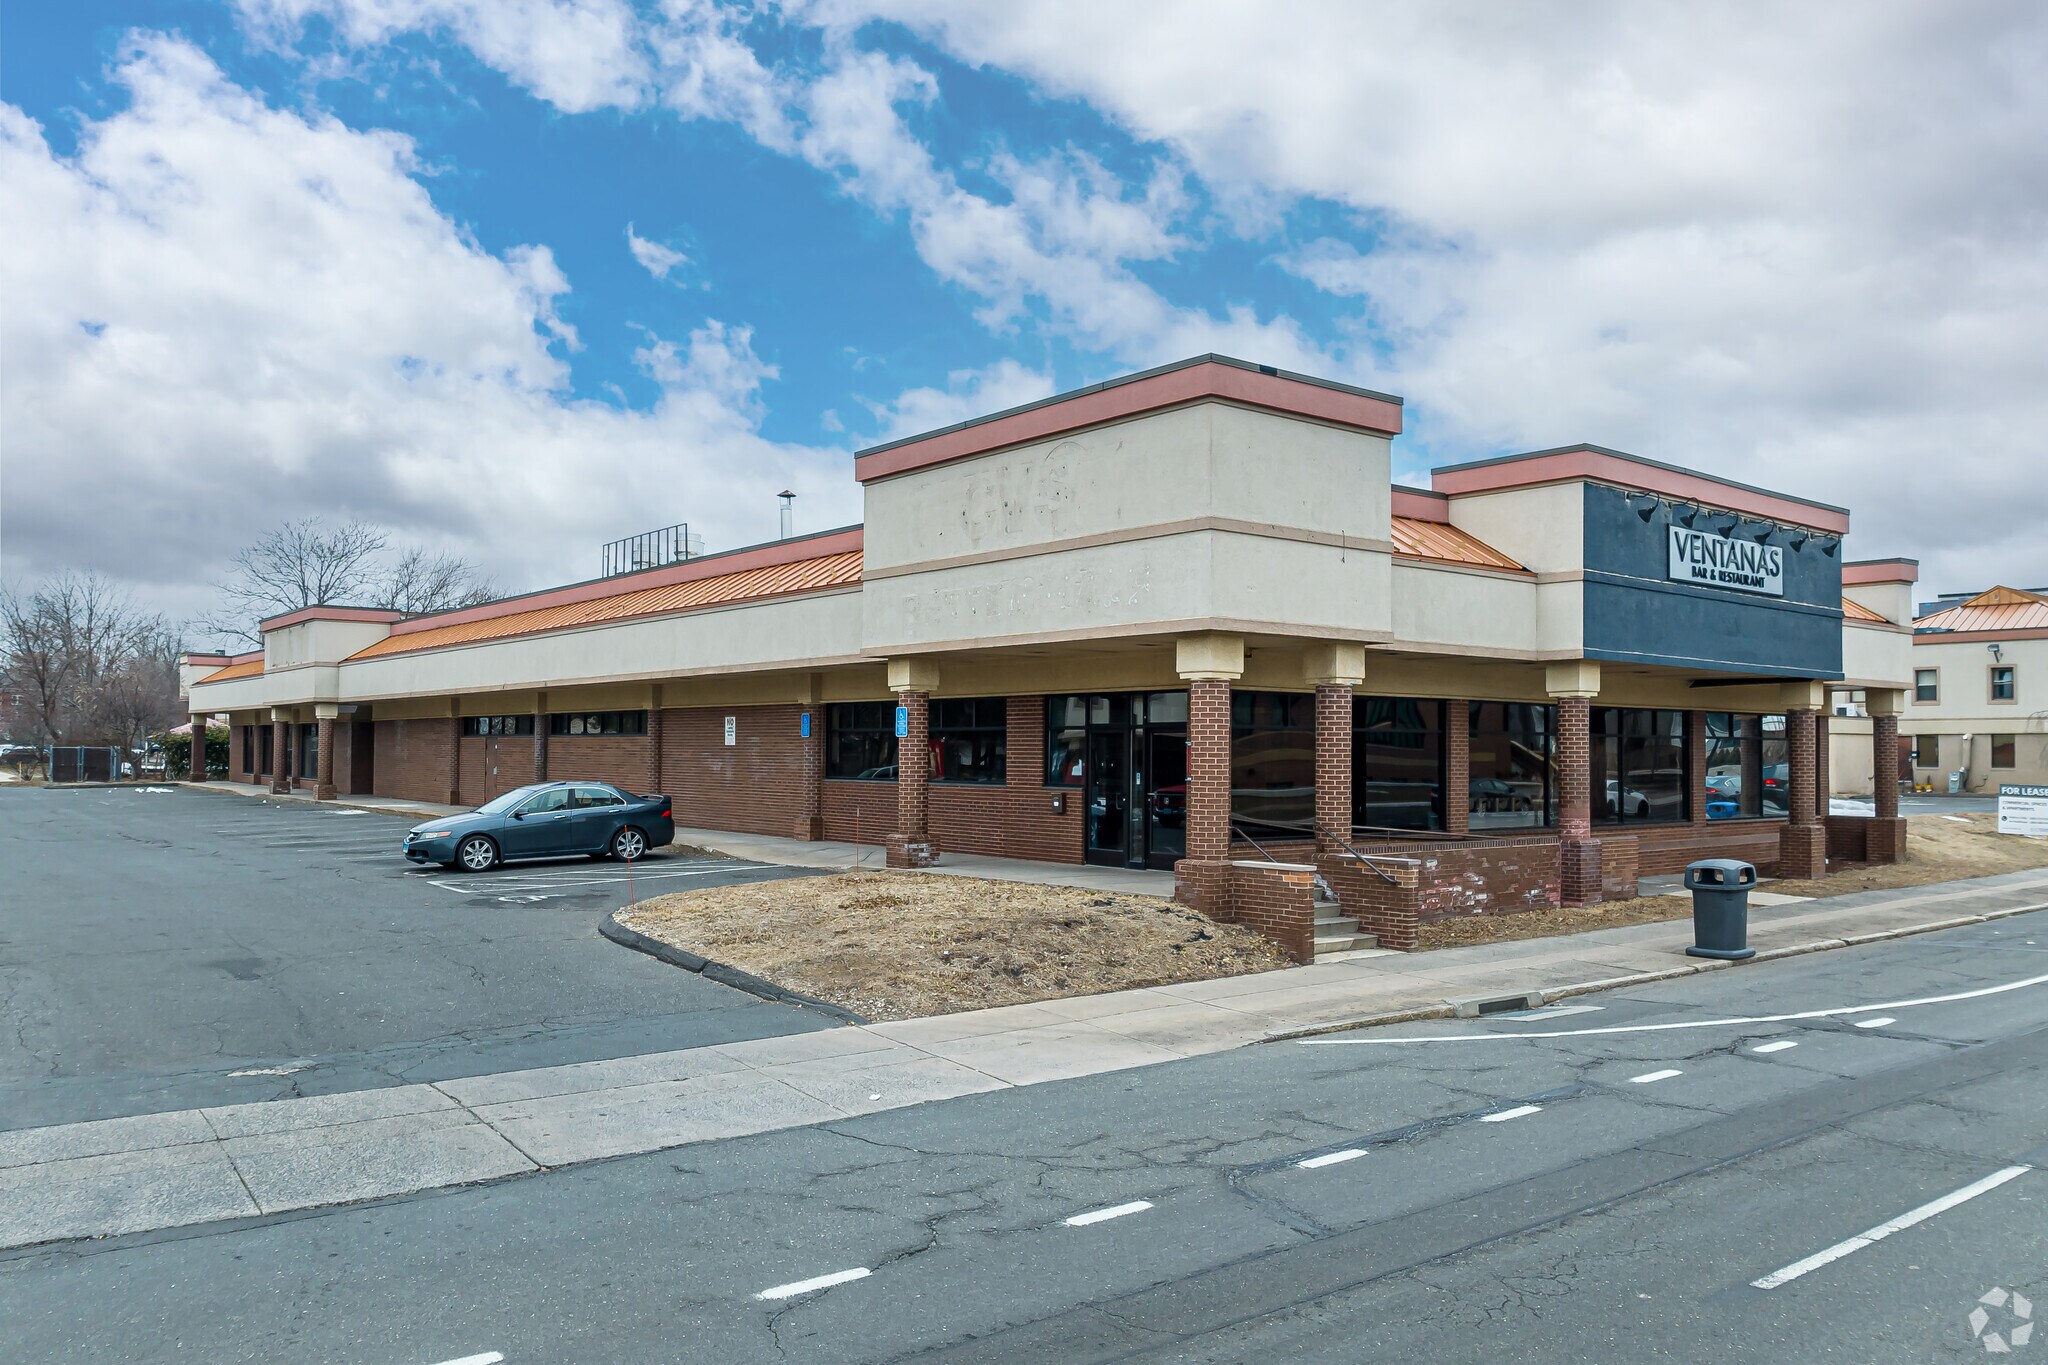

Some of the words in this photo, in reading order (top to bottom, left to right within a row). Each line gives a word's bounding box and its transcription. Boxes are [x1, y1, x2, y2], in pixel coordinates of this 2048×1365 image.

[1674, 531, 1780, 577] VENTANAS
[1692, 566, 1707, 579] BAR
[1710, 569, 1716, 580] &
[1719, 570, 1765, 588] RESTAURANT
[2001, 787, 2020, 795] FOR
[2021, 788, 2048, 796] LEASE
